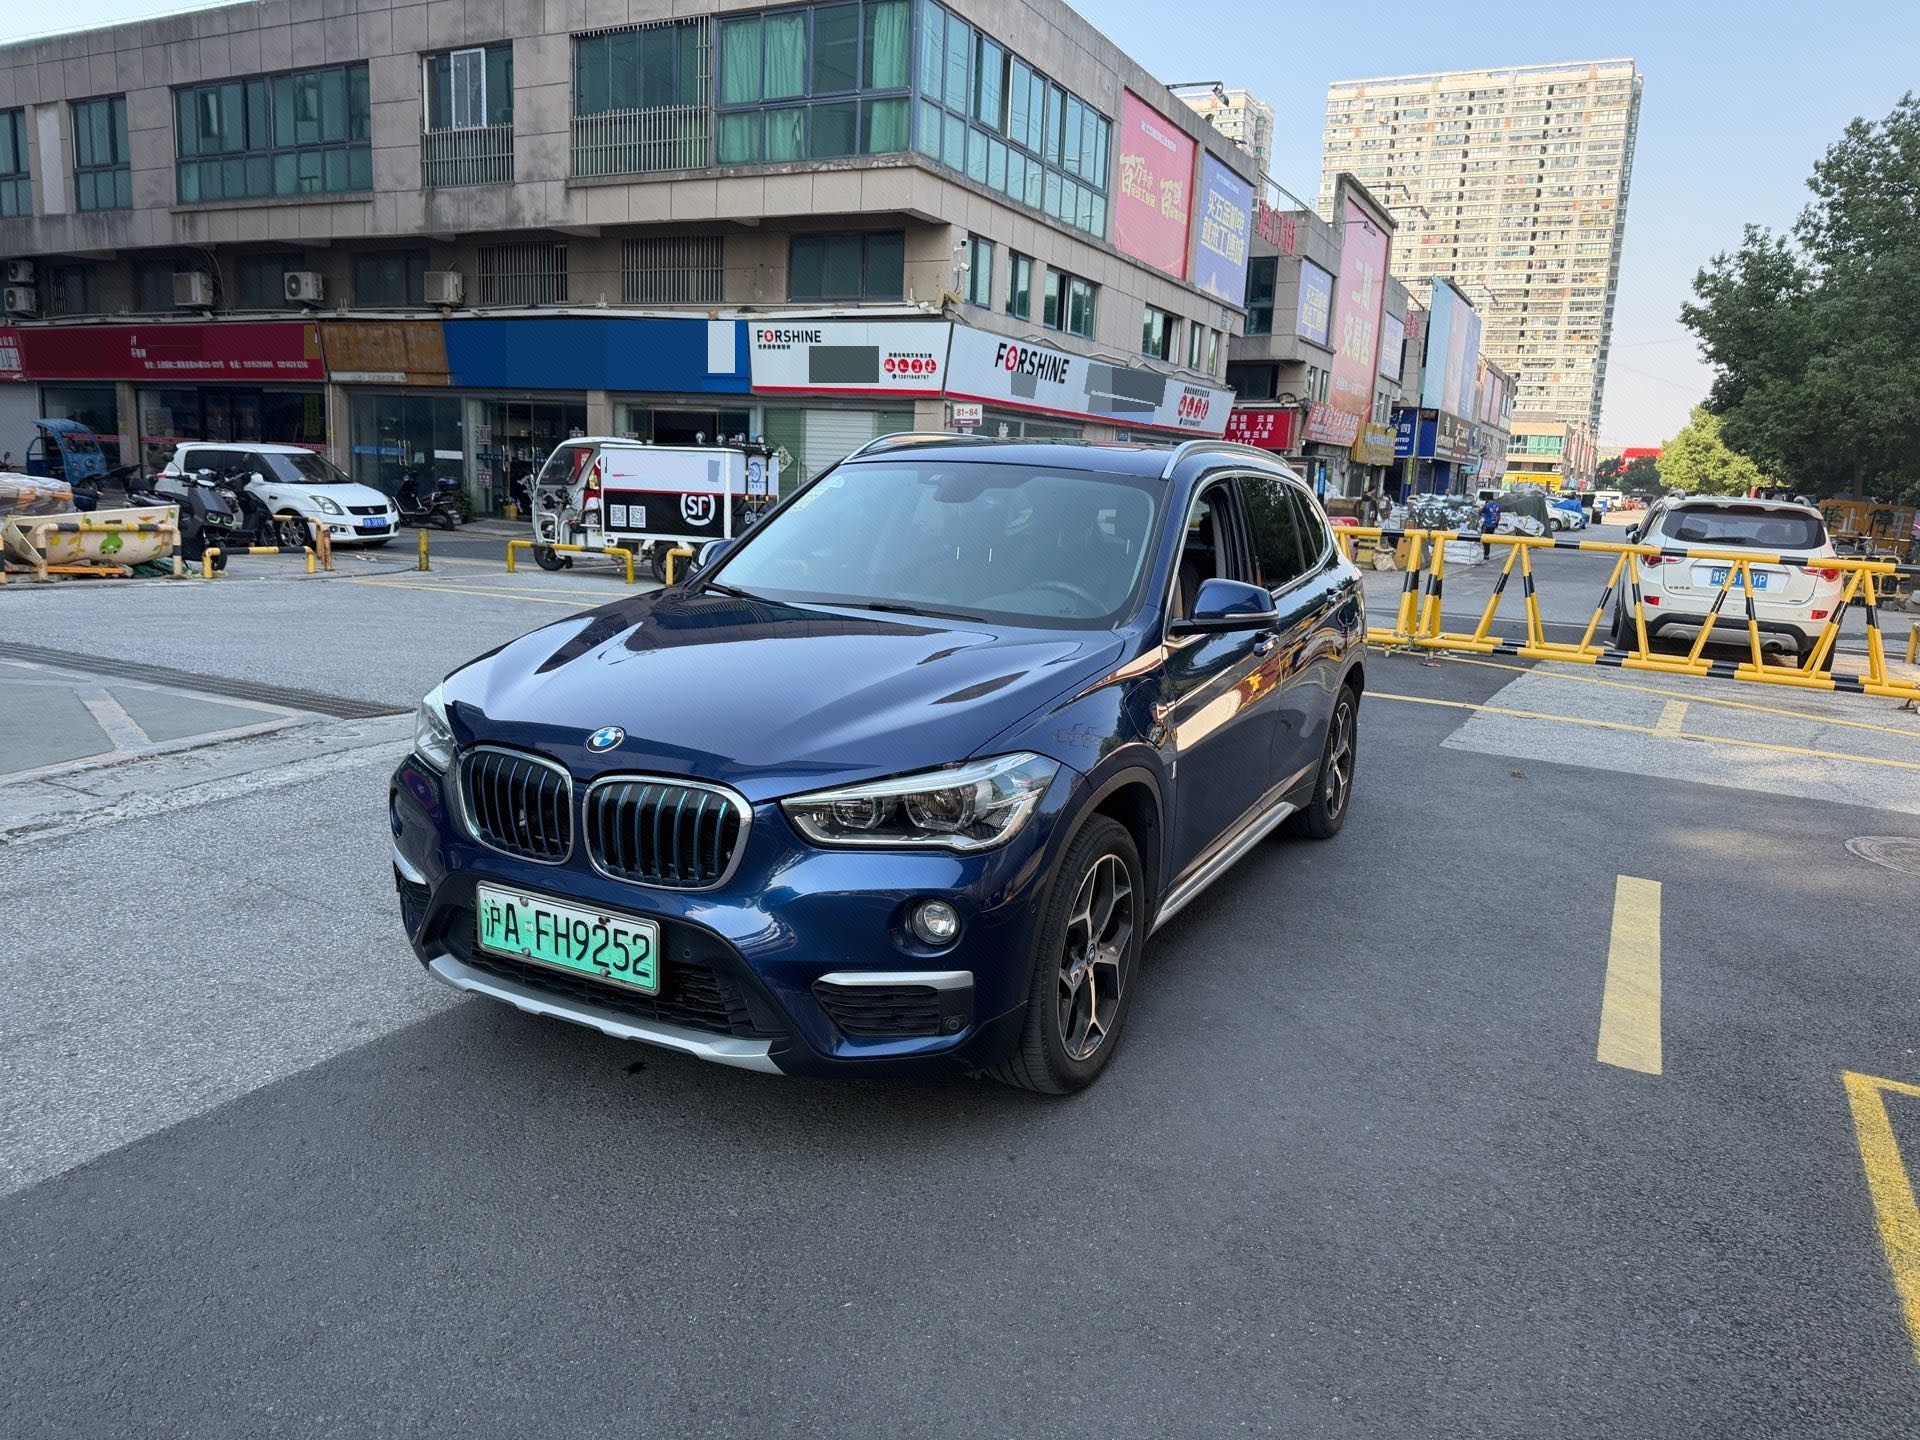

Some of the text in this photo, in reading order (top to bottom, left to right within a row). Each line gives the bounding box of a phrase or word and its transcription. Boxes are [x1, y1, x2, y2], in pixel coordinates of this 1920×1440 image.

[757, 329, 822, 343] FORSHINE
[994, 342, 1070, 385] FORSHINE
[956, 408, 979, 417] 81-84
